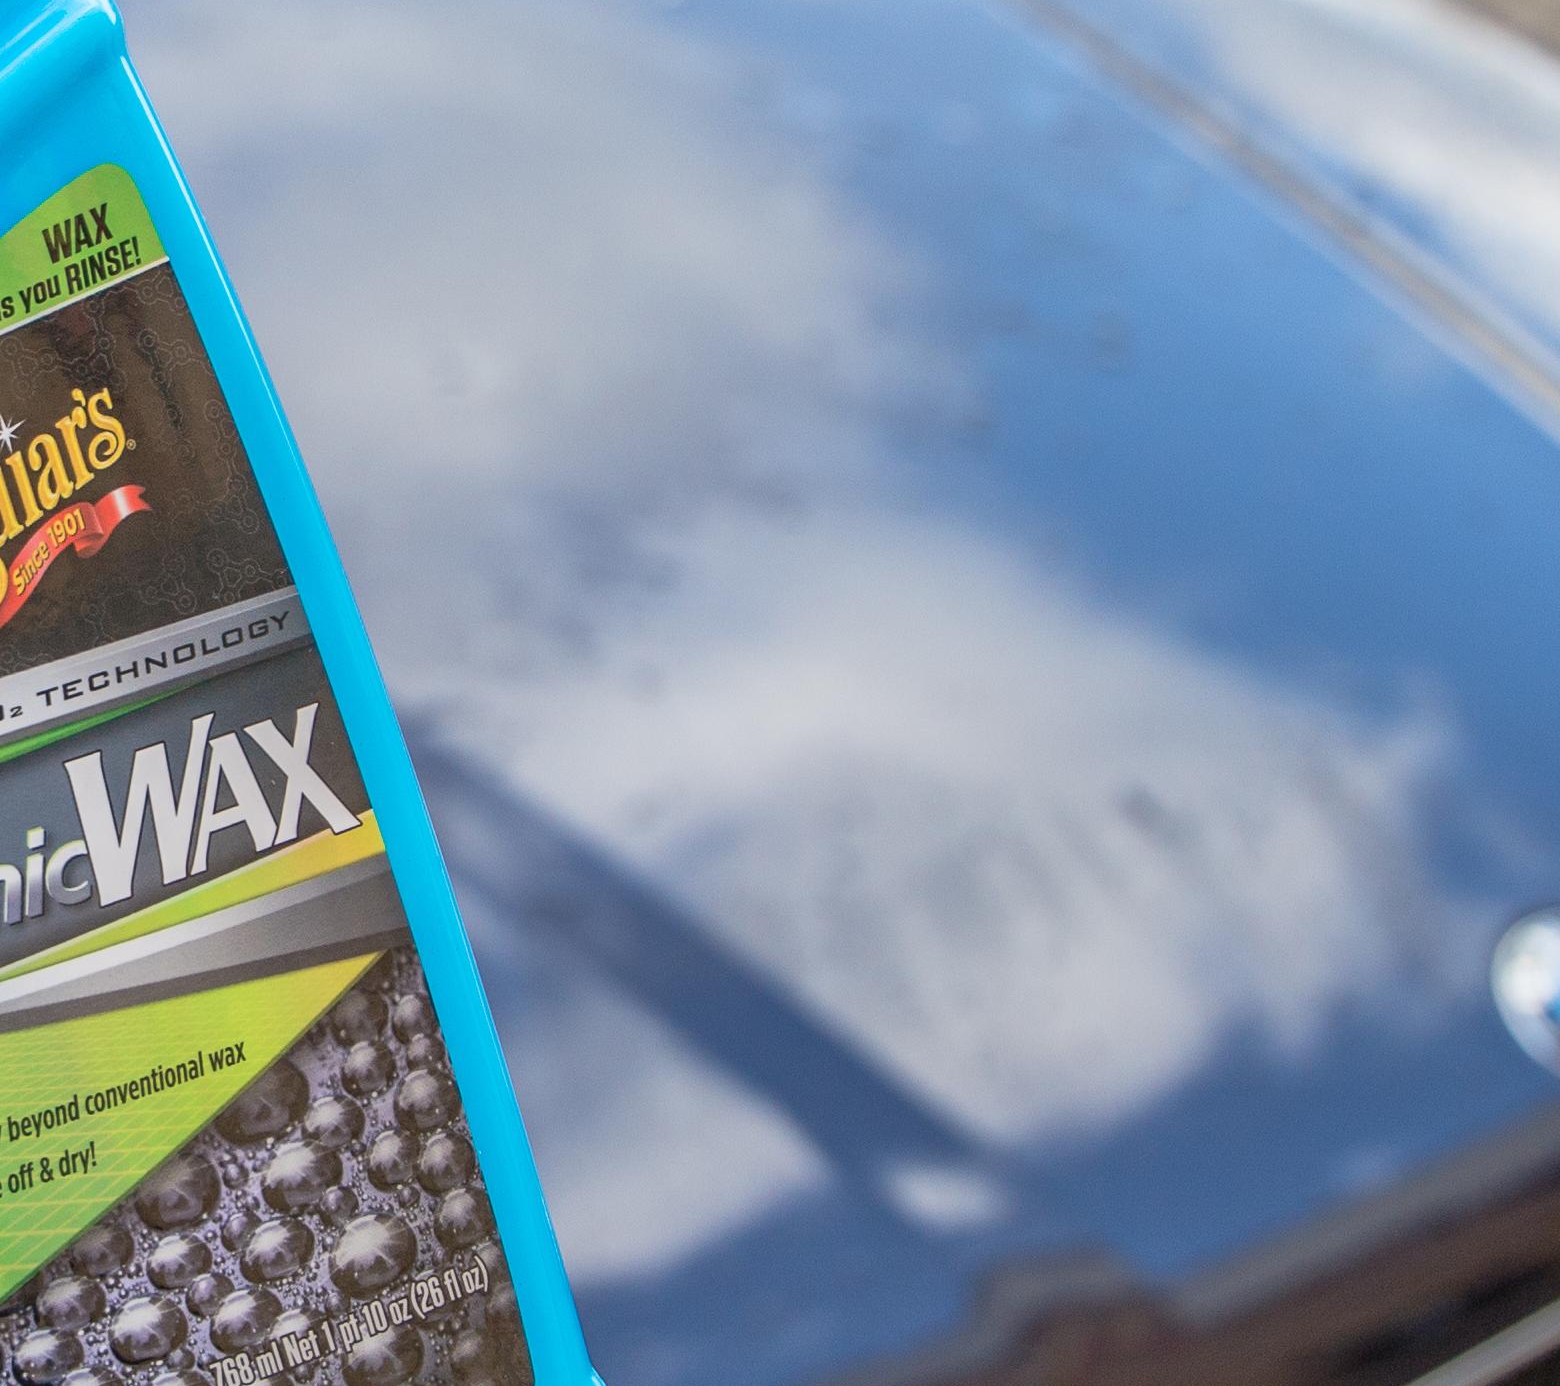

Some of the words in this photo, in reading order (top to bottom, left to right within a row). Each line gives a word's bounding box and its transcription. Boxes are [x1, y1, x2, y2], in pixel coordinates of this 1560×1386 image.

[19, 275, 61, 314] you
[64, 236, 142, 295] RINSE!
[42, 203, 113, 264] WAX
[12, 543, 49, 597] Since
[46, 509, 85, 549] 1901
[36, 611, 290, 706] TECHNOLOGY
[63, 702, 363, 909] WAX
[7, 1094, 80, 1142] beyond
[85, 1050, 204, 1116] conventional
[209, 1041, 246, 1072] wax
[8, 1161, 34, 1194] off
[40, 1157, 54, 1183] &
[59, 1141, 97, 1178] dry!
[255, 1349, 284, 1379] ml
[282, 1329, 320, 1368] Net
[321, 1320, 336, 1353] 1
[339, 1312, 362, 1353] pt
[361, 1299, 388, 1337] 10
[390, 1296, 413, 1326] oz
[410, 1277, 440, 1319] (26
[443, 1272, 463, 1306] fl
[464, 1254, 489, 1295] oz)
